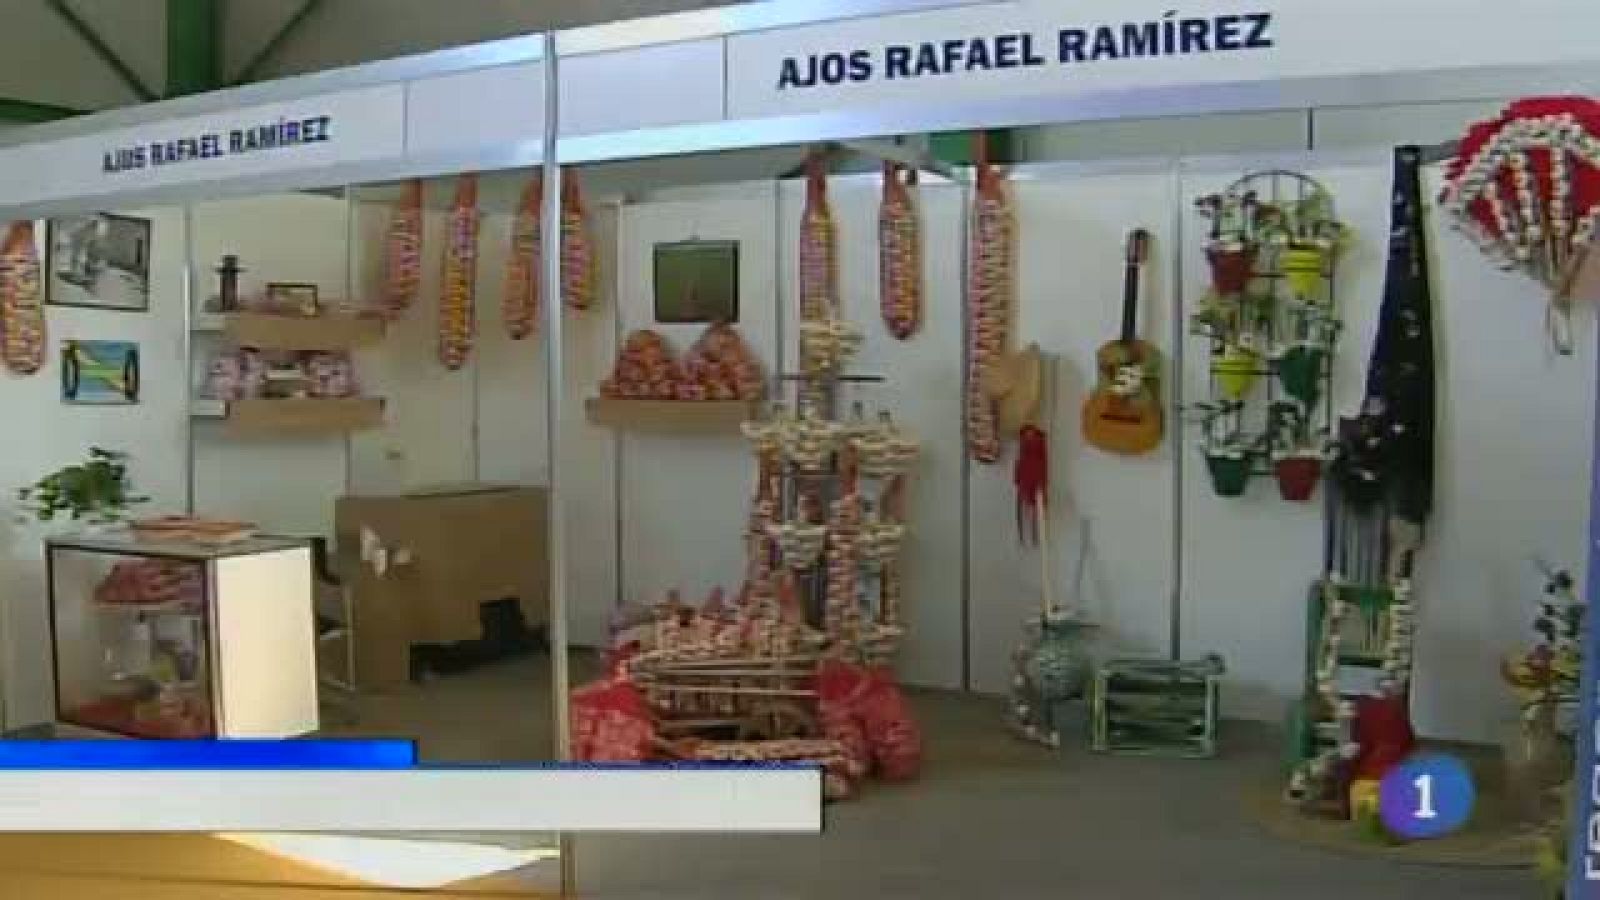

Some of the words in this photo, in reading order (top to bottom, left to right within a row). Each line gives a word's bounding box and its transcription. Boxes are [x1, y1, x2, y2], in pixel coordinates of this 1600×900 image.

[778, 50, 873, 89] AJOS
[884, 33, 1046, 80] RAFAEL
[1058, 10, 1274, 64] RAMÍREZ
[150, 133, 224, 166] RAFAEL
[229, 115, 330, 154] RAMÍREZ
